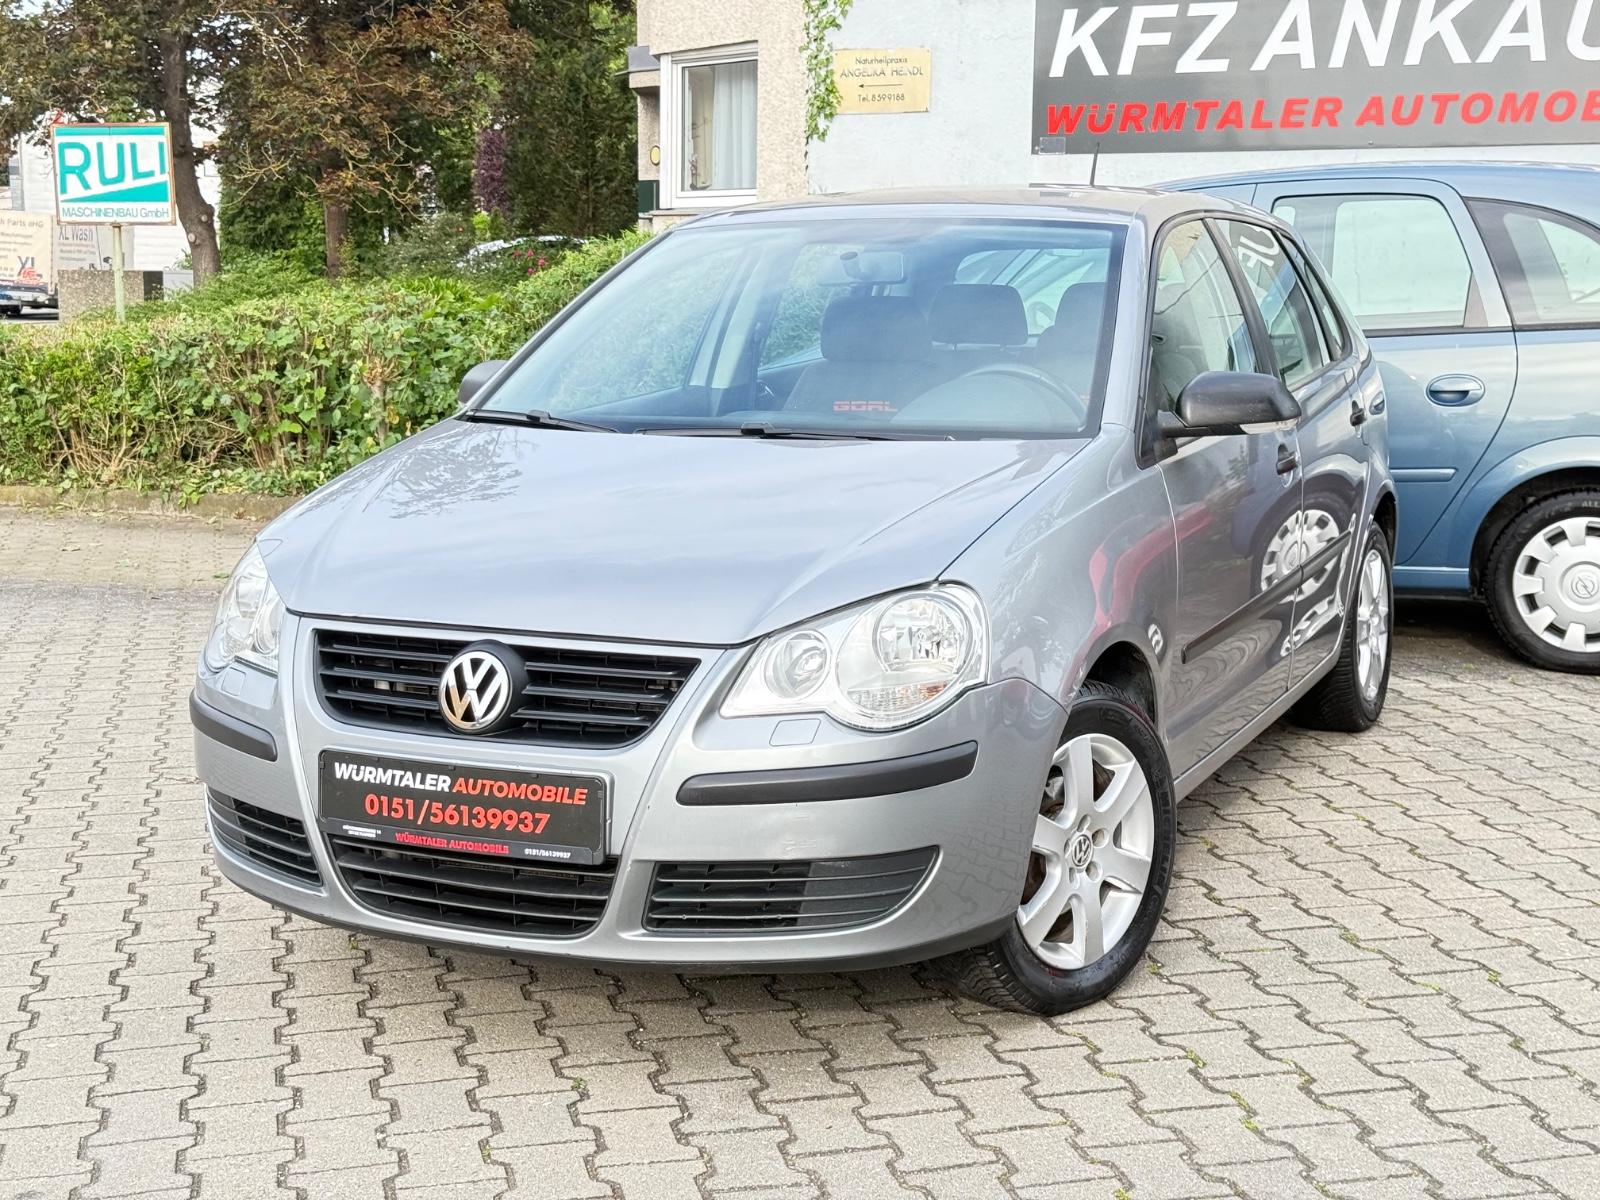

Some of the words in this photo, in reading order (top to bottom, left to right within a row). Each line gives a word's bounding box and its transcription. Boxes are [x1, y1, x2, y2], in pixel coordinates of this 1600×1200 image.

[1048, 1, 1239, 78] KFZ
[840, 68, 886, 78] ANGELIKA
[855, 56, 908, 66] Naturheilpraxis
[1046, 97, 1344, 135] WÜRMTALER
[58, 141, 167, 195] RULI
[62, 207, 139, 218] MASCHINENBAU
[140, 207, 169, 218] GmbH
[440, 652, 511, 732] VW
[334, 761, 451, 793] WÜRMTALER
[452, 777, 588, 805] AUTOMOBILE
[365, 793, 550, 834] 0151/56139937
[395, 832, 447, 848] WÜRMTALER
[449, 840, 509, 854] AUTOMOBILE
